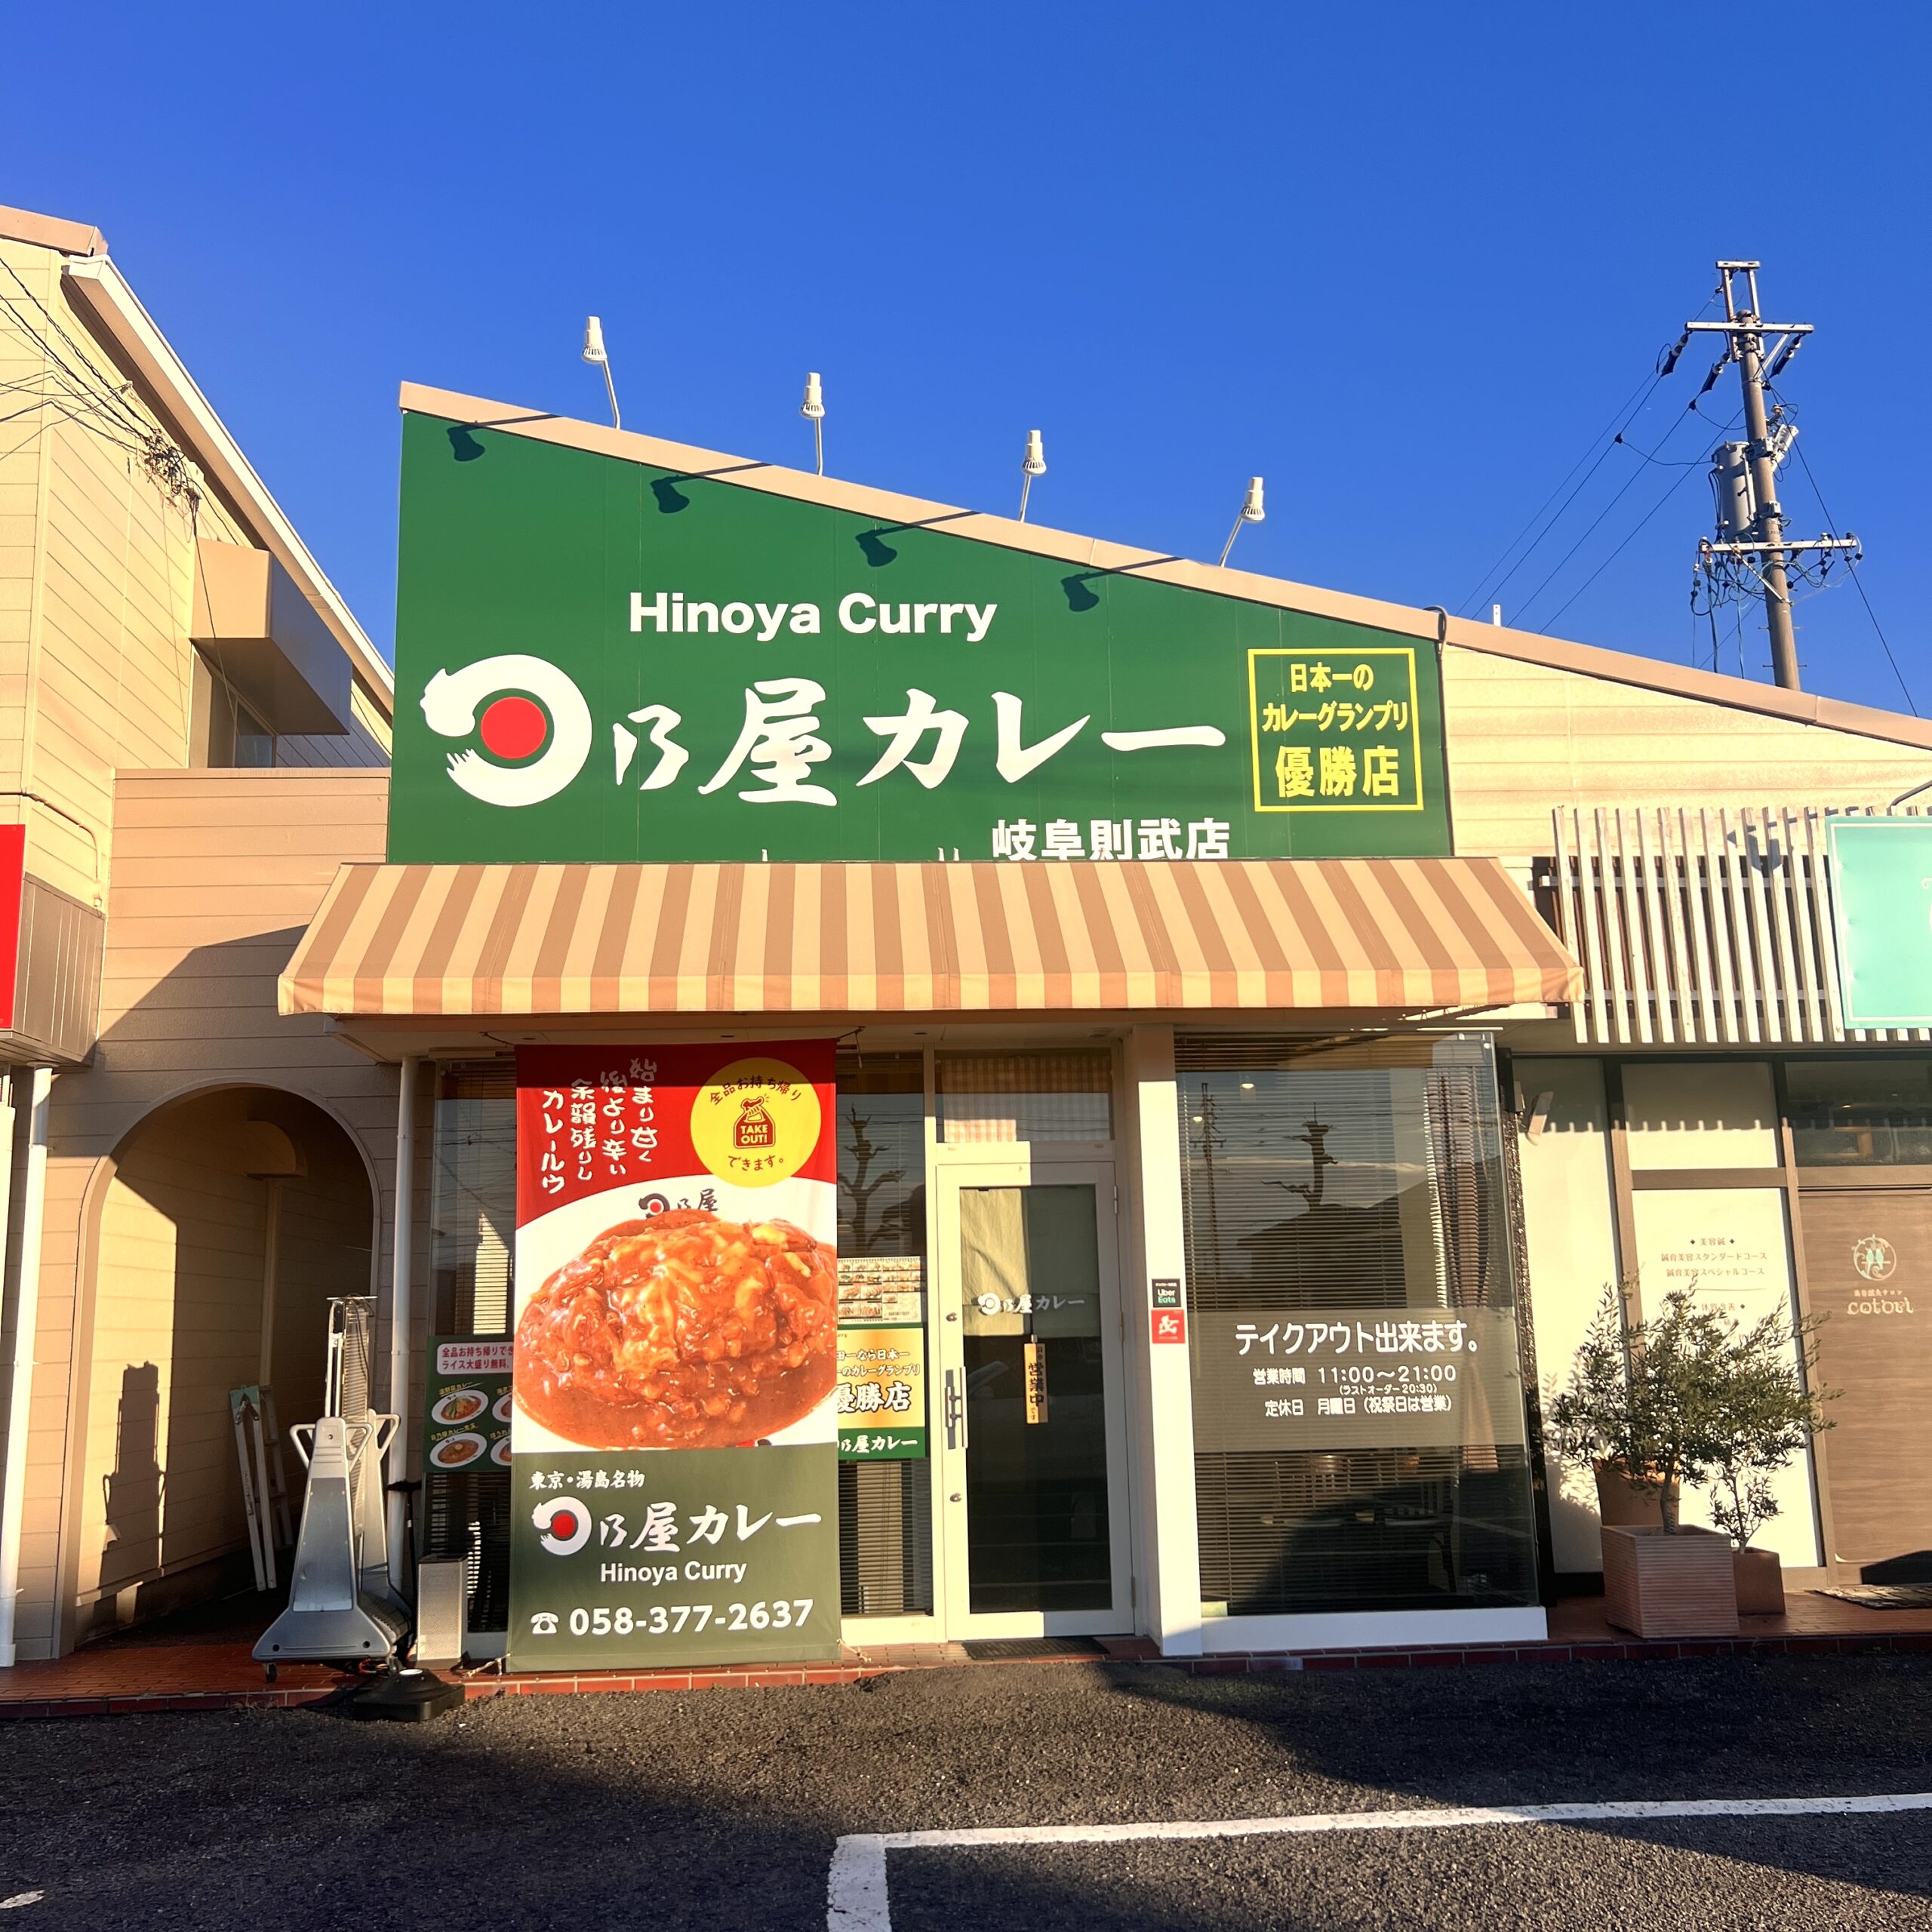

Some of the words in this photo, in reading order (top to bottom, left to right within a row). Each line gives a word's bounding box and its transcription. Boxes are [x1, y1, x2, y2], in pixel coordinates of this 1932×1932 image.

[630, 592, 821, 641] Hinoya
[838, 592, 998, 642] Curry
[1291, 662, 1374, 693] 日本一の
[1262, 700, 1408, 731] カレーグランプリ
[1275, 745, 1399, 798] 優勝店
[992, 817, 1230, 860] 岐阜則武店
[710, 1075, 801, 1106] 全品お持ち帰り
[629, 1058, 658, 1162] 始まり甘く
[740, 1124, 768, 1134] TAKE
[740, 1134, 768, 1144] OUT!
[728, 1154, 784, 1171] できます。
[1158, 1288, 1175, 1297] Uber
[1158, 1296, 1176, 1304] Eats
[1235, 1319, 1478, 1355] テイクアウト出来ます。
[1253, 1367, 1306, 1386] 営業時間
[1265, 1399, 1304, 1417] 定休日
[529, 1469, 645, 1491] 東京・湯島名物
[601, 1562, 678, 1586] Hinoya
[685, 1561, 747, 1583] Curry
[569, 1598, 814, 1636] 058-377-2637
